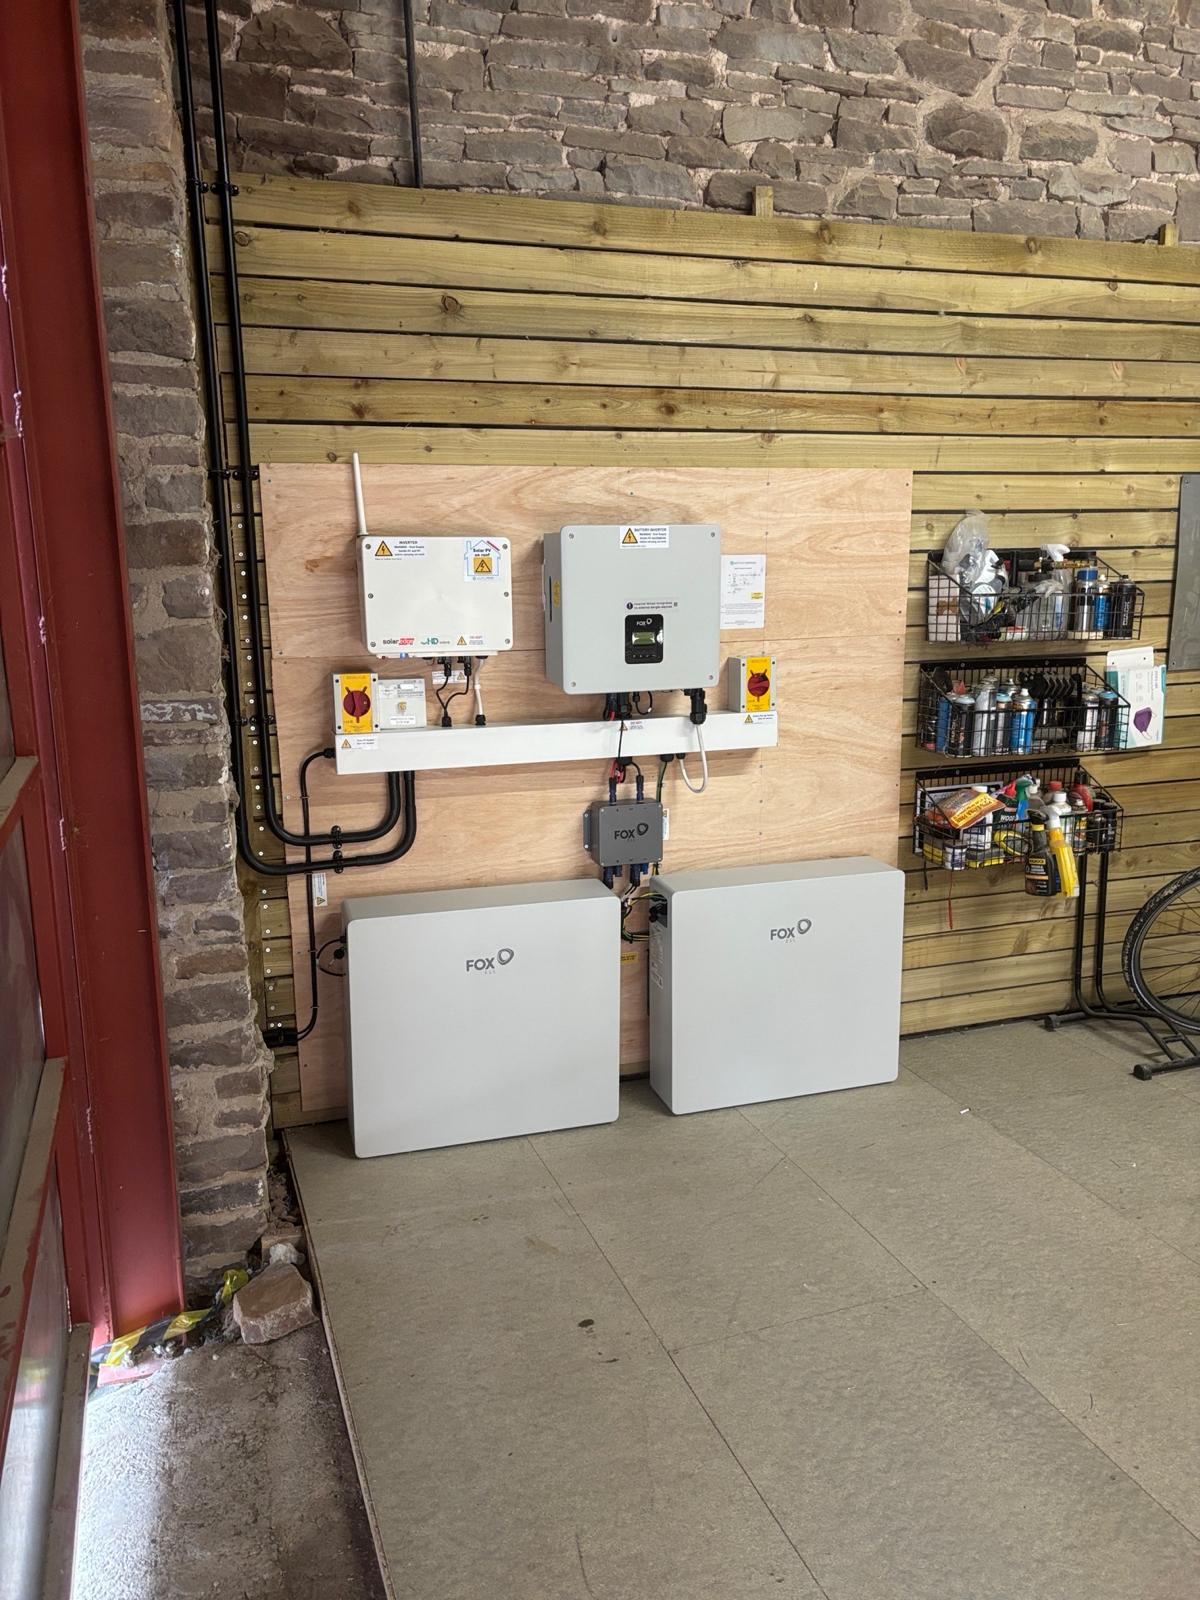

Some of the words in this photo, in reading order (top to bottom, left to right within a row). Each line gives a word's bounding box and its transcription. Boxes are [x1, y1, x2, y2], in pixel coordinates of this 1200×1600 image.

[614, 828, 636, 840] FOX
[770, 927, 796, 941] FOX
[466, 957, 495, 972] FOX
